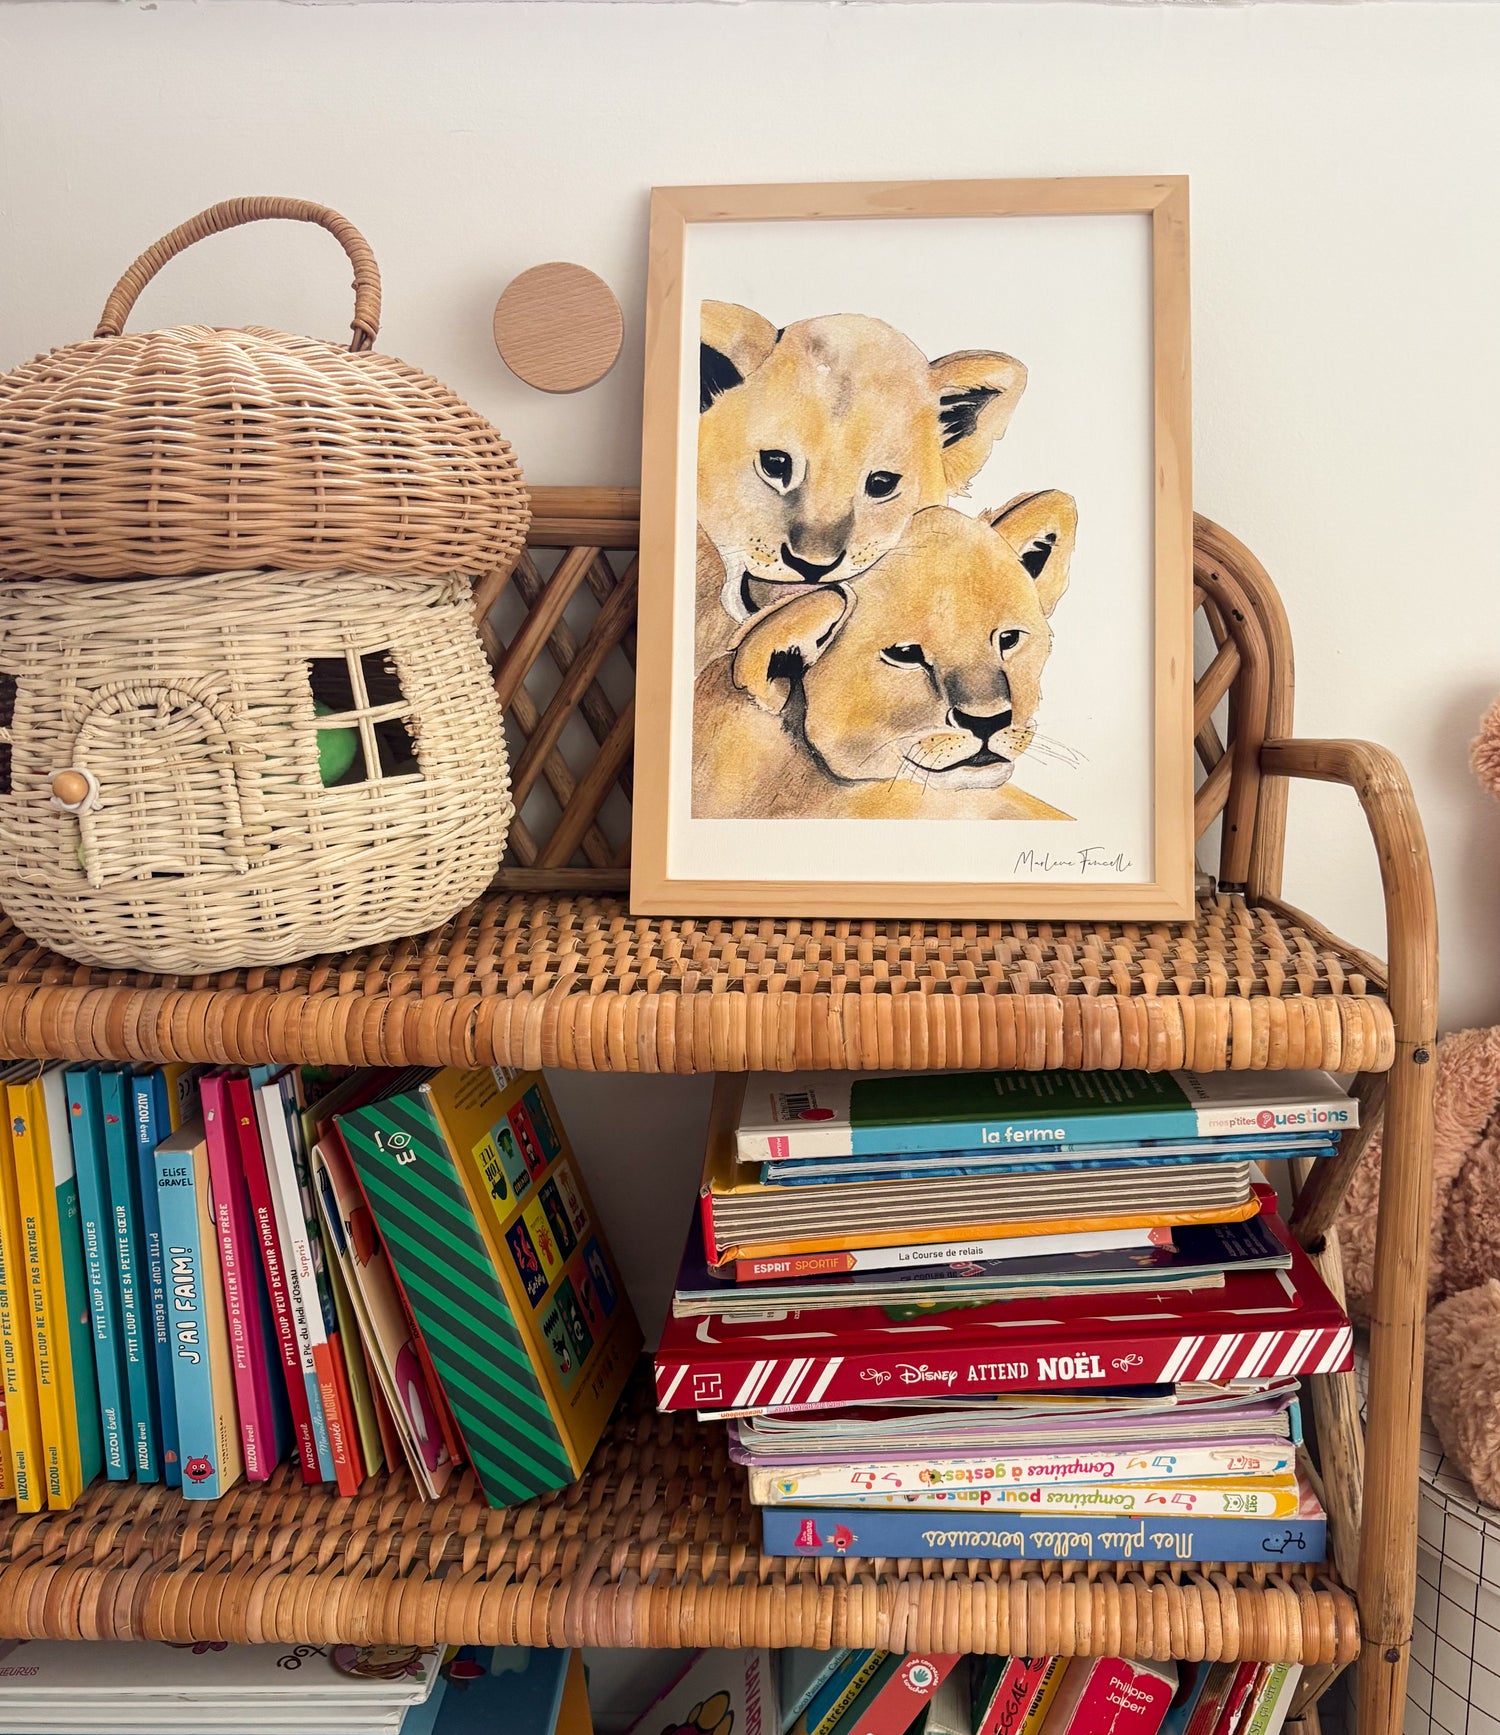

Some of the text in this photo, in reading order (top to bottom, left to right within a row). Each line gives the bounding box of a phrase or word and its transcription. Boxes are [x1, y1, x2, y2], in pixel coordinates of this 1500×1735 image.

[137, 1092, 150, 1143] AUZOU éveil
[1209, 1108, 1348, 1130] mes p'tites Questions
[982, 1126, 1066, 1144] la ferme
[158, 1178, 194, 1187] GRAVEL
[296, 1245, 310, 1278] Surpris
[753, 1257, 840, 1274] ESPRIT SPORTIF
[898, 1246, 984, 1261] La Course de relais
[90, 1261, 101, 1285] FÊTE
[116, 1205, 139, 1362] P'TIT LOUP AIME SA PETITE SŒUR
[219, 1203, 246, 1369] P'TIT LOUP DEVIENT GRAND FRÈRE
[258, 1207, 297, 1366] P'TIT LOUP VEUT DEVENIR POMPIER
[0, 1289, 9, 1308] SON
[26, 1216, 51, 1385] P'TIT LOUP NE VEUT PAS PARTAGER
[94, 1289, 105, 1312] LOUP
[149, 1232, 167, 1344] P'TIT LOUP SE DÉGUISE
[0, 1312, 12, 1336] FÊTE
[96, 1315, 107, 1339] P'TIT
[290, 1269, 314, 1368] le Pic du Midi d'Ossau
[5, 1339, 15, 1364] LOUP
[176, 1320, 201, 1365] J'AI
[8, 1367, 17, 1393] P'TIT
[967, 1361, 1029, 1381] ATTEND
[1037, 1352, 1106, 1381] NOËL
[321, 1382, 338, 1421] MAGIQUE
[105, 1407, 121, 1468] AUZOU éveil
[137, 1422, 149, 1470] AUZOU éveil
[245, 1425, 258, 1472] AUZOU éveil
[329, 1422, 343, 1454] musée
[305, 1442, 316, 1470] AUZOU
[945, 1458, 1115, 1482] Comptines à gestes
[16, 1451, 29, 1501] AUZOU éveil
[48, 1447, 61, 1496] AUZOU éveil
[996, 1488, 1041, 1503] pour
[1046, 1489, 1136, 1510] Comptines
[1250, 1495, 1258, 1512] Lito
[922, 1520, 1194, 1558] Mes plus belles berceuses
[826, 1689, 857, 1722] trésors
[853, 1676, 865, 1689] de
[862, 1653, 882, 1676] Popi
[1109, 1676, 1154, 1703] Philippe
[994, 1678, 1028, 1735] EGGAE
[1106, 1692, 1146, 1715] Jalbert
